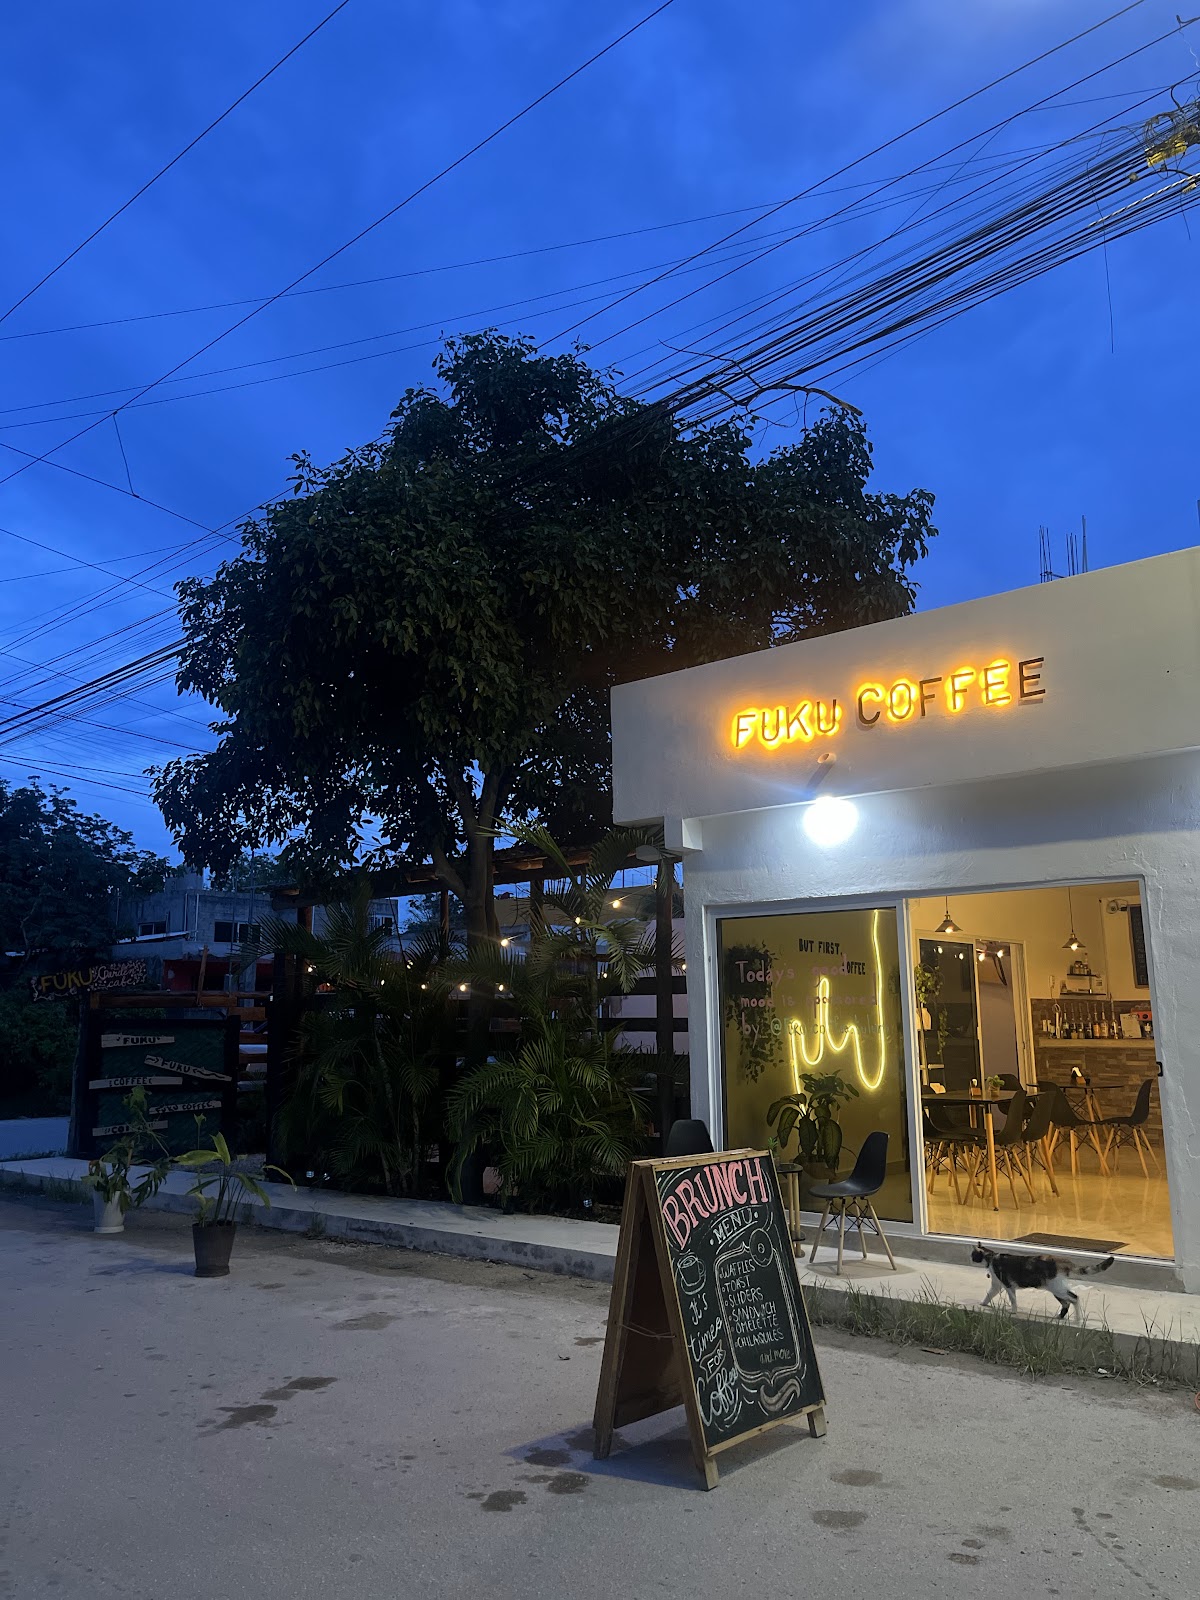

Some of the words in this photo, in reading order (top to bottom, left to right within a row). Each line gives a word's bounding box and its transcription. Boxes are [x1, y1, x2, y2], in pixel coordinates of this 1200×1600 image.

[735, 699, 837, 748] FUKU
[858, 656, 1046, 726] COFFEE
[123, 1036, 156, 1045] FUKU
[160, 1060, 191, 1073] FUKU
[663, 1158, 768, 1250] BRUNCH
[713, 1208, 753, 1244] MENU
[721, 1258, 756, 1278] WAFFLES
[724, 1274, 751, 1293] TOAST
[728, 1287, 764, 1308] SLIDERS
[735, 1313, 780, 1334] OMELETTE
[707, 1348, 723, 1374] FOR
[696, 1367, 739, 1427] Coffee
